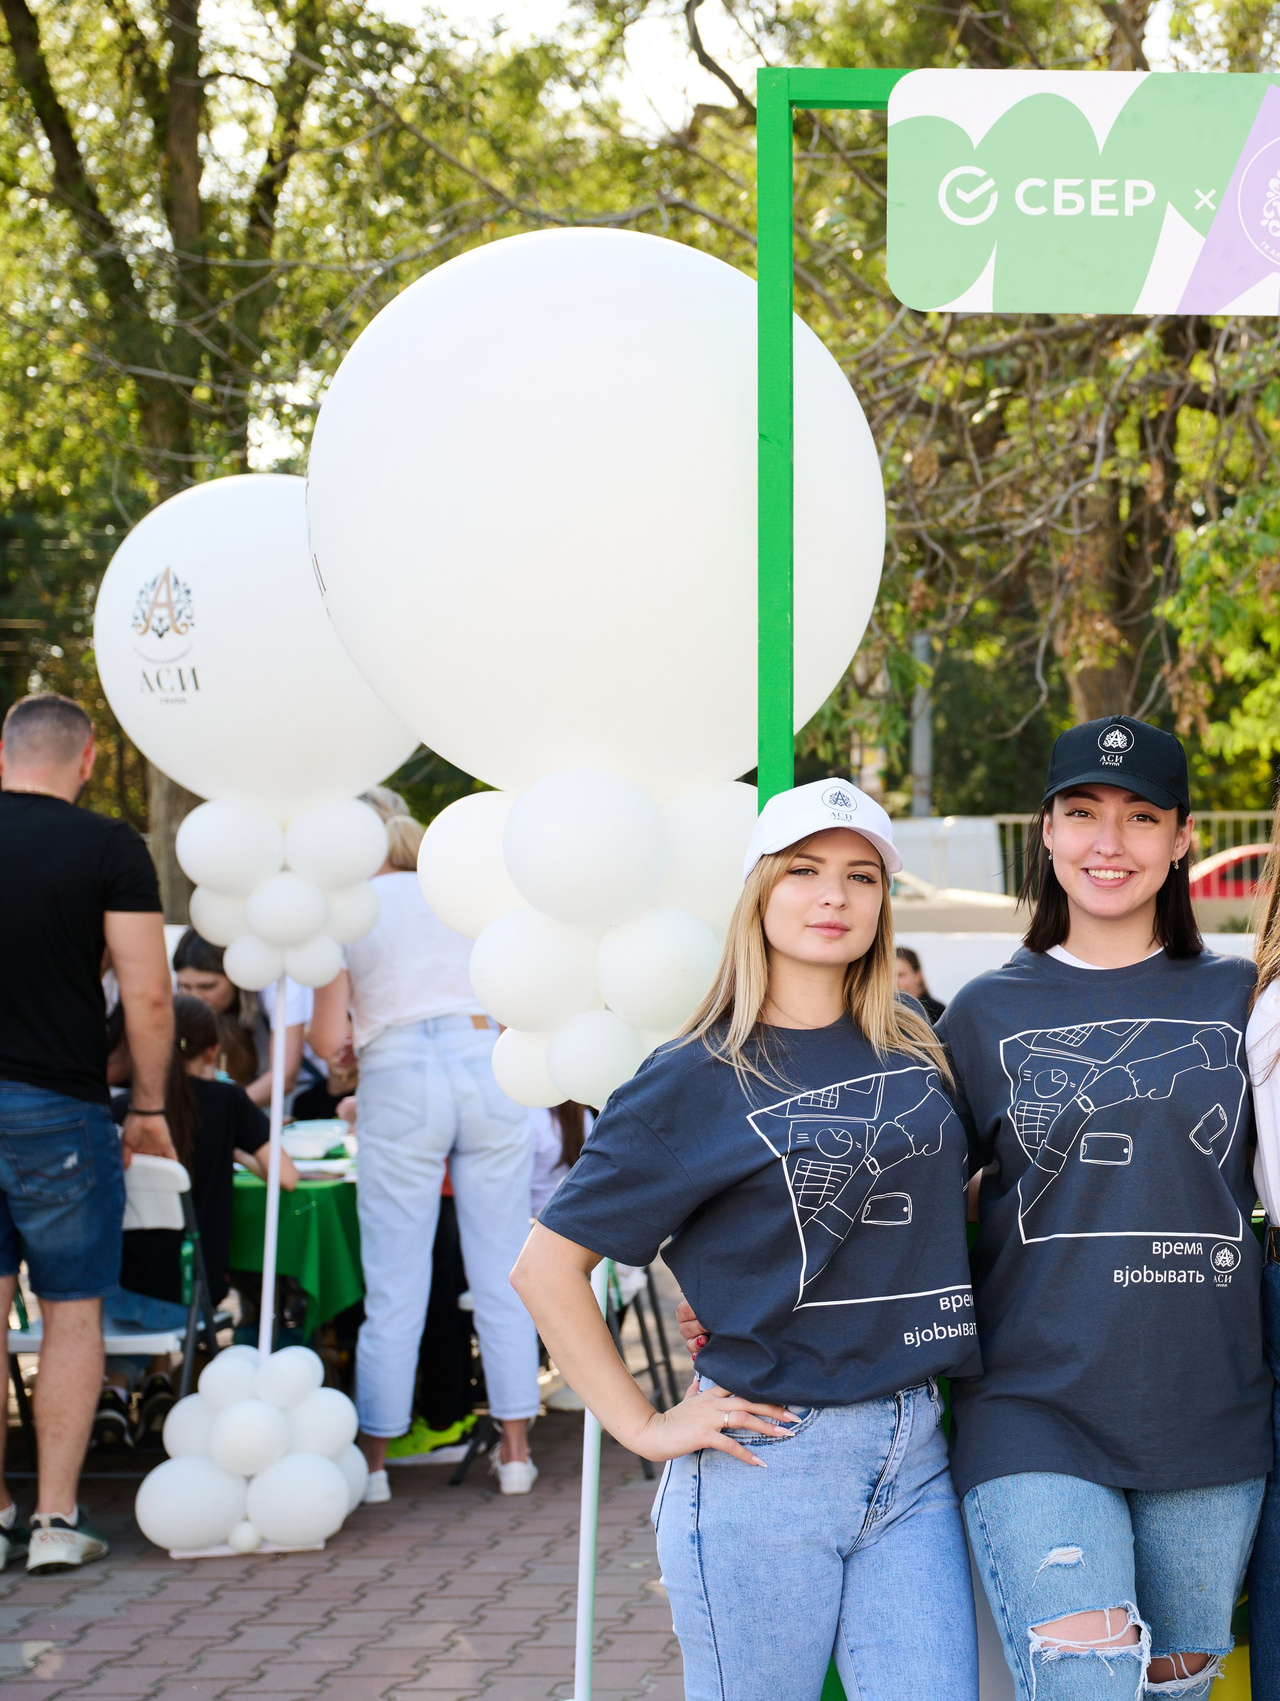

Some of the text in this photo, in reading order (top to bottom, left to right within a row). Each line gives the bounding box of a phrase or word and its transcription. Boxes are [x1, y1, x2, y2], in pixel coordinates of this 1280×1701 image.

[1014, 177, 1156, 217] СБЕР
[1260, 240, 1271, 252] ГК
[139, 666, 200, 694] АСИ
[1099, 754, 1124, 764] АСИ
[1152, 1241, 1204, 1259] время
[1213, 1273, 1232, 1284] АСИ
